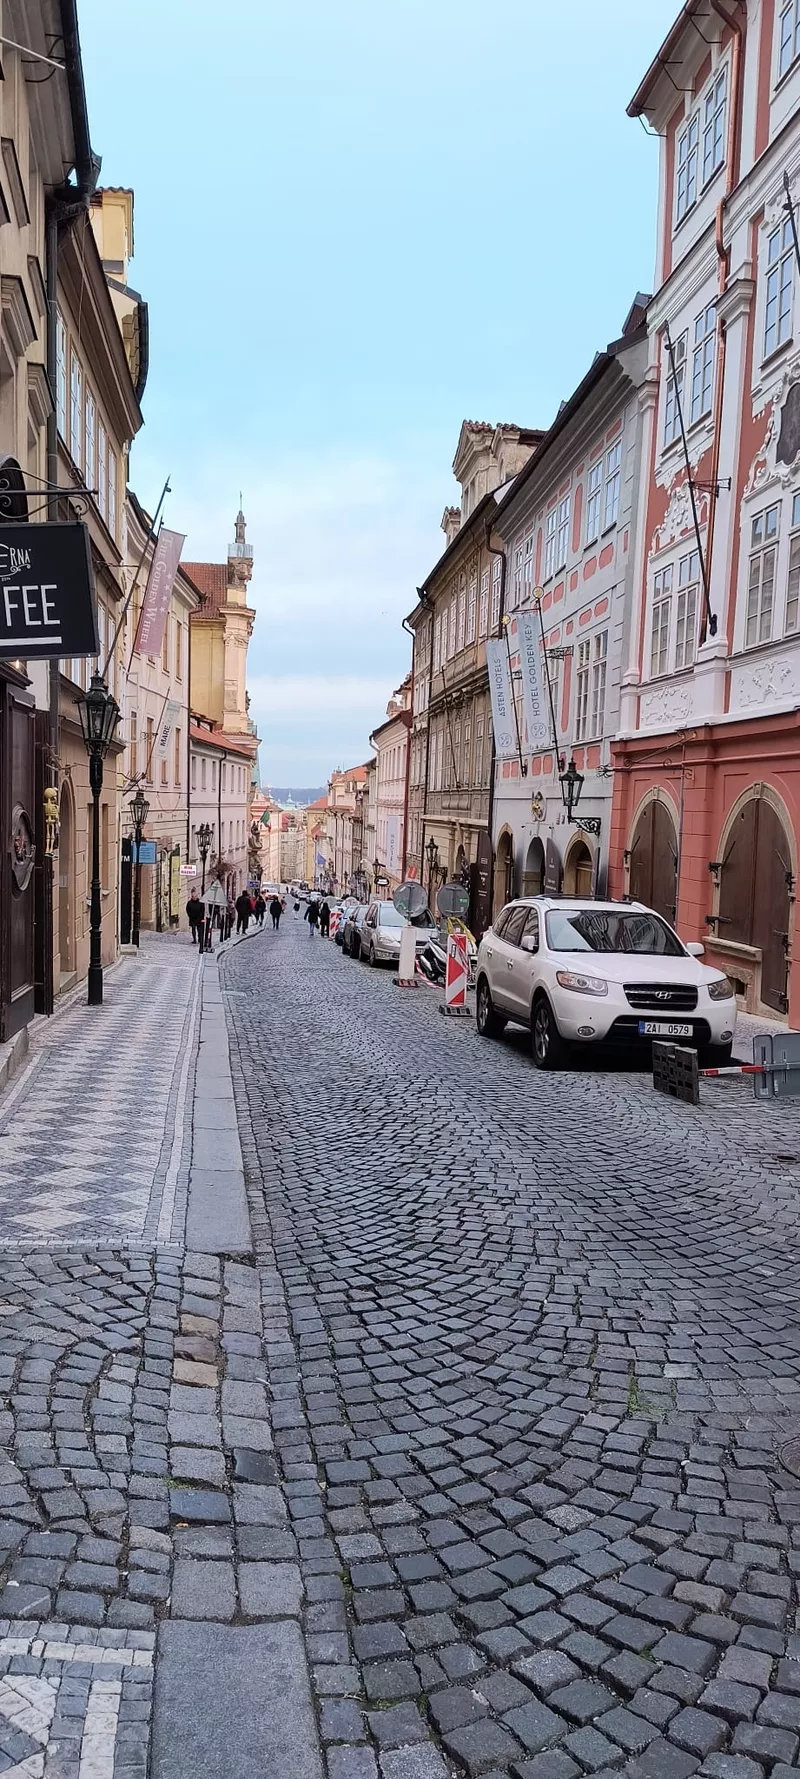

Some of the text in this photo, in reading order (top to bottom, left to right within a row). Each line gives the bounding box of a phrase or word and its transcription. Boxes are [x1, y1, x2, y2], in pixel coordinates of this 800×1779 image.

[148, 562, 168, 604] GOLDEN
[3, 584, 61, 627] FEE
[494, 658, 506, 717] ASTEN HOTELS
[524, 624, 541, 717] HOTEL GOLDEN KEY
[160, 724, 171, 747] MARE
[668, 1025, 689, 1035] 0579
